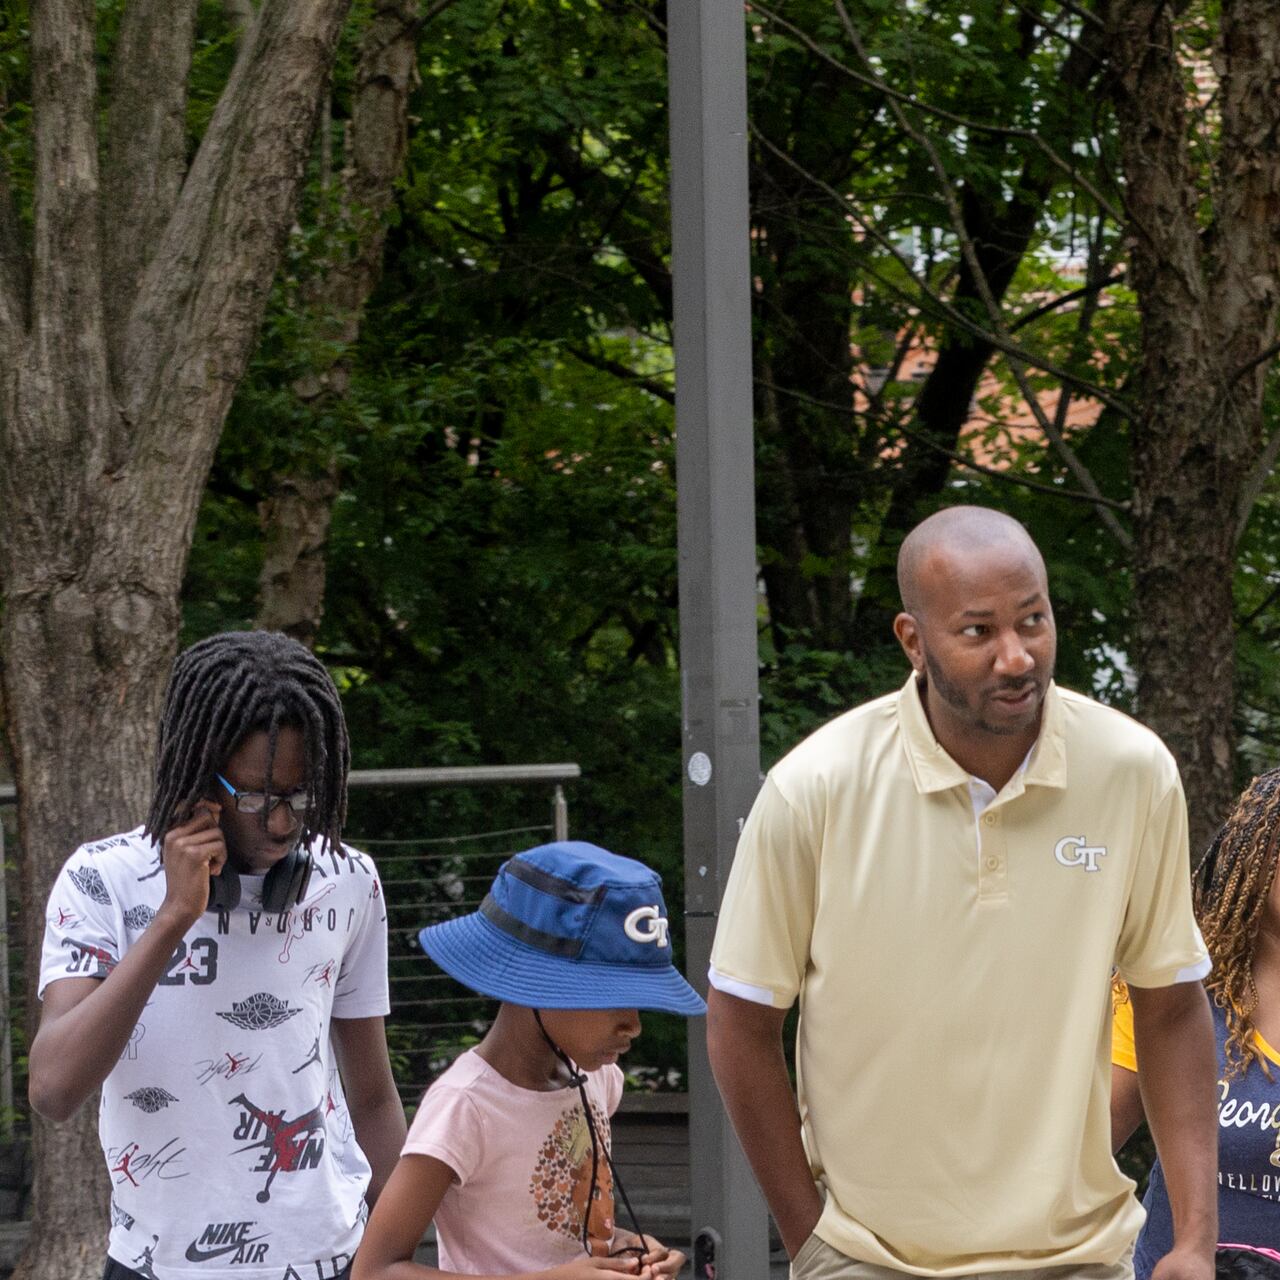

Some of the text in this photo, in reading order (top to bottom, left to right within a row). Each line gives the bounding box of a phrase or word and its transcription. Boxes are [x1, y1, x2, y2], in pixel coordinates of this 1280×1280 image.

[1054, 834, 1107, 872] GT
[158, 937, 218, 985] 23
[253, 1138, 325, 1172] NIE
[199, 1222, 254, 1246] NIKE
[230, 1243, 270, 1264] AIR
